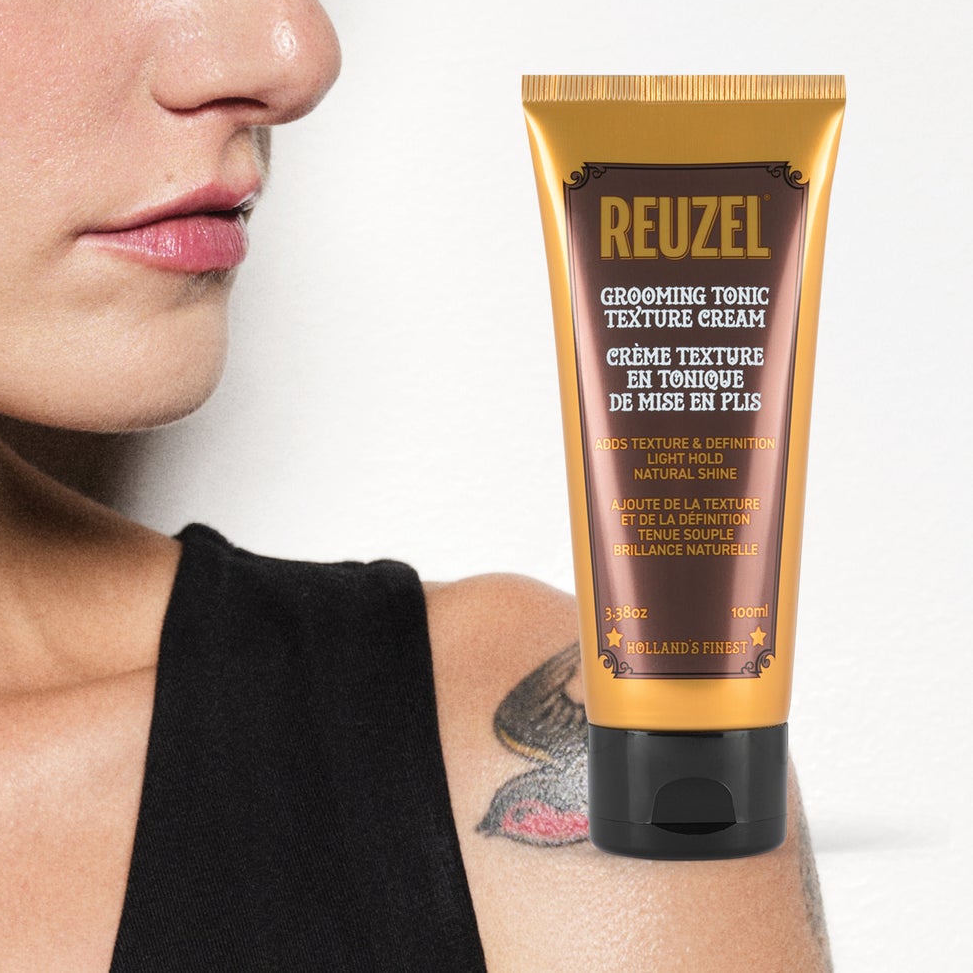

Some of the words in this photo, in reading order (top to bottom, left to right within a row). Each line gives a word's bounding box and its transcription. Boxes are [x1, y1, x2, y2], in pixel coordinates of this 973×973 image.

[600, 286, 706, 305] GROOMING
[711, 286, 769, 305] TONIC
[604, 306, 692, 328] TEXTURE
[698, 309, 765, 328] CREAM
[606, 343, 671, 366] CRÈME
[676, 347, 764, 366] TEXTURE
[627, 370, 652, 388] EN
[657, 369, 744, 390] TONIQUE
[609, 393, 633, 411] DE
[638, 393, 685, 411] MISE
[689, 392, 715, 411] EN
[721, 392, 761, 411] PLIS
[595, 438, 628, 449] ADDS
[631, 438, 689, 449] TEXTURE
[693, 438, 702, 449] &
[706, 438, 775, 449] DEFINITION
[647, 453, 685, 465] LIGHT
[689, 453, 723, 465] HOLD
[634, 468, 694, 480] NATURAL
[698, 468, 737, 480] SHINE
[611, 499, 660, 510] AJOUTE
[664, 499, 680, 510] DE
[684, 499, 700, 510] LA
[704, 498, 760, 510] TEXTURE
[621, 514, 635, 525] ET
[639, 514, 655, 525] DE
[659, 514, 675, 525] LA
[679, 511, 750, 525] DÉFINITION
[638, 529, 680, 540] TENUE
[684, 529, 734, 540] SOUPLE
[614, 544, 683, 556] BRILLANCE
[686, 544, 758, 555] NATURELLE
[605, 606, 648, 621] 3.38oz
[731, 604, 768, 618] 100ml
[627, 639, 699, 654] HOLLAND'S
[703, 641, 748, 654] FINEST
